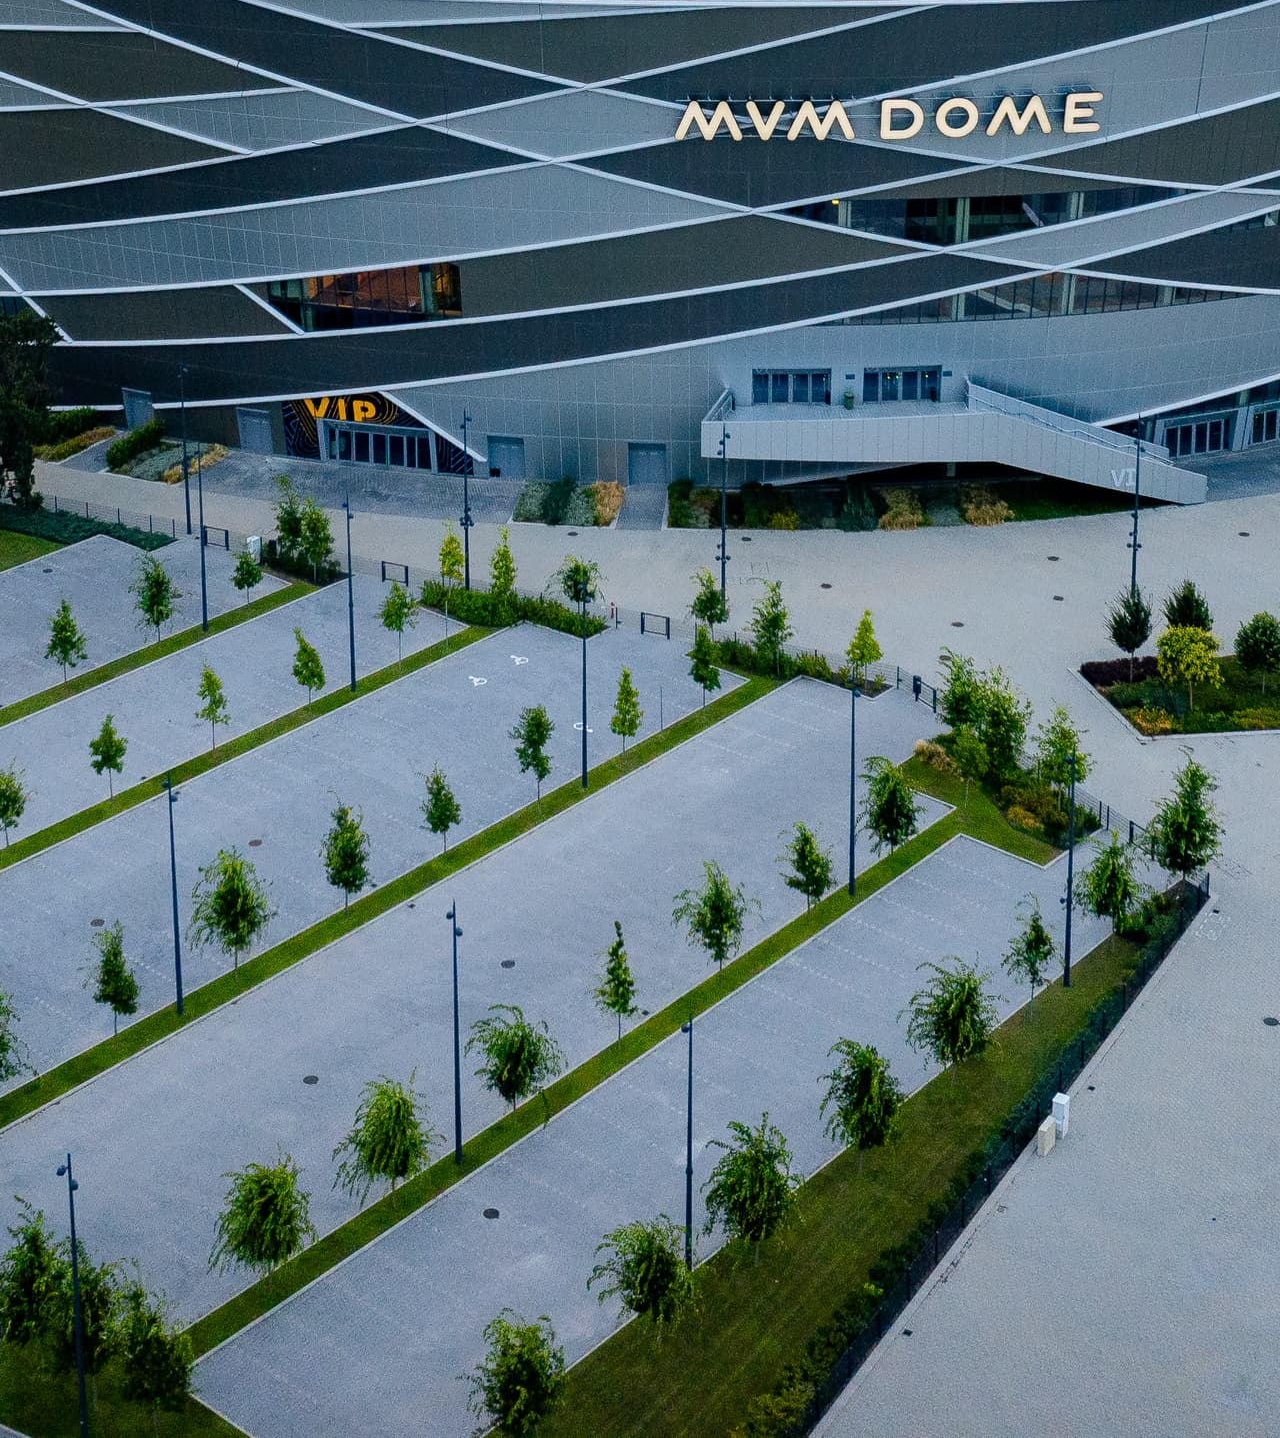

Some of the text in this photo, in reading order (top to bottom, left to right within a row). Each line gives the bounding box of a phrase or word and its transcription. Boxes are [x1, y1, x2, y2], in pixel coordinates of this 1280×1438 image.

[674, 92, 1104, 142] MVM DOME
[303, 397, 376, 422] VIP
